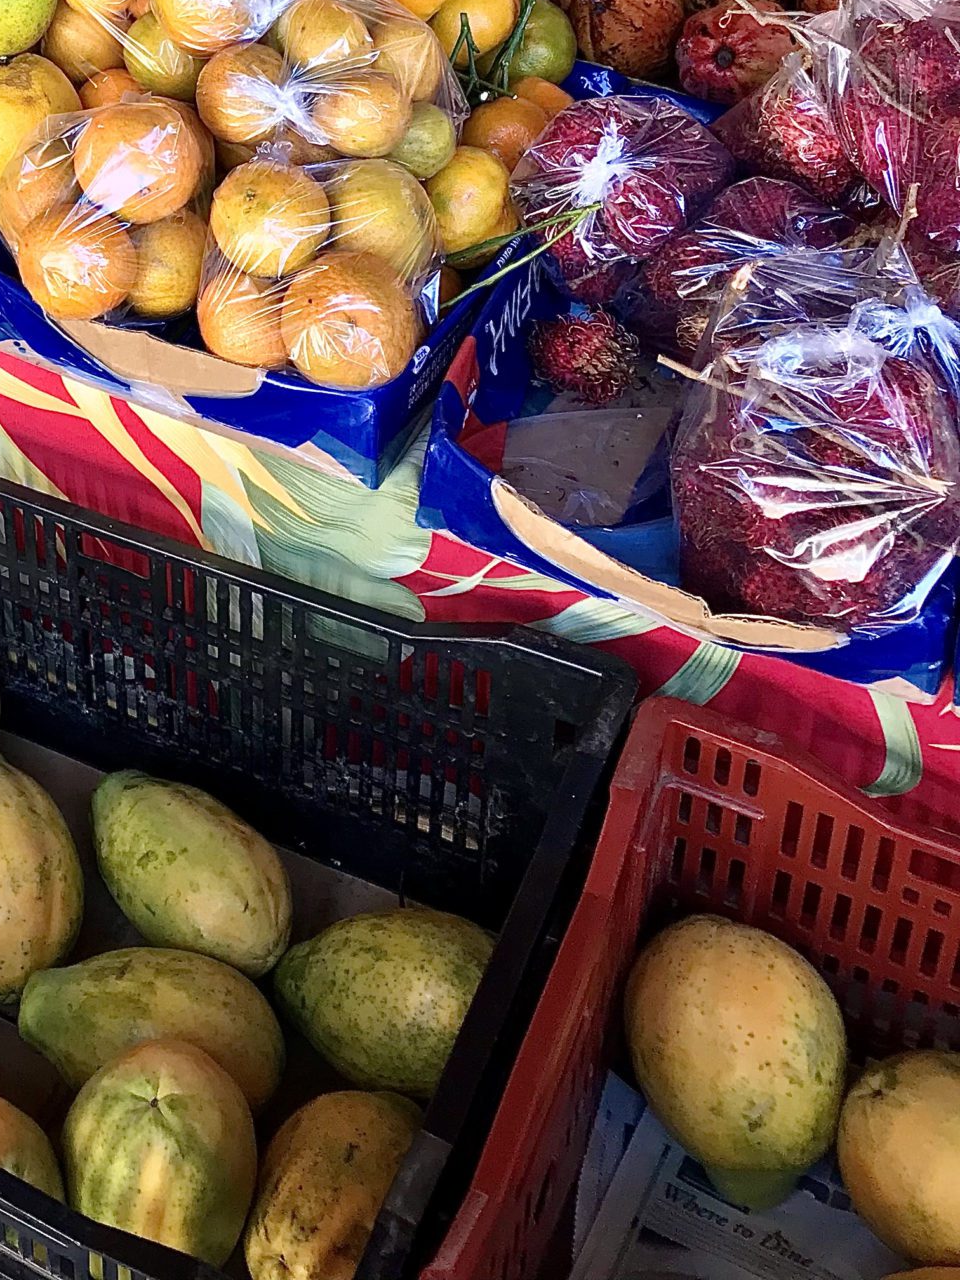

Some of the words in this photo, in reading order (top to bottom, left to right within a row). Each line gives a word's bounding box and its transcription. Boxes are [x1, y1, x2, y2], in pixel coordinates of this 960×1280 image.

[665, 1182, 729, 1227] Where
[733, 1223, 756, 1240] to
[759, 1231, 814, 1267] Dine
